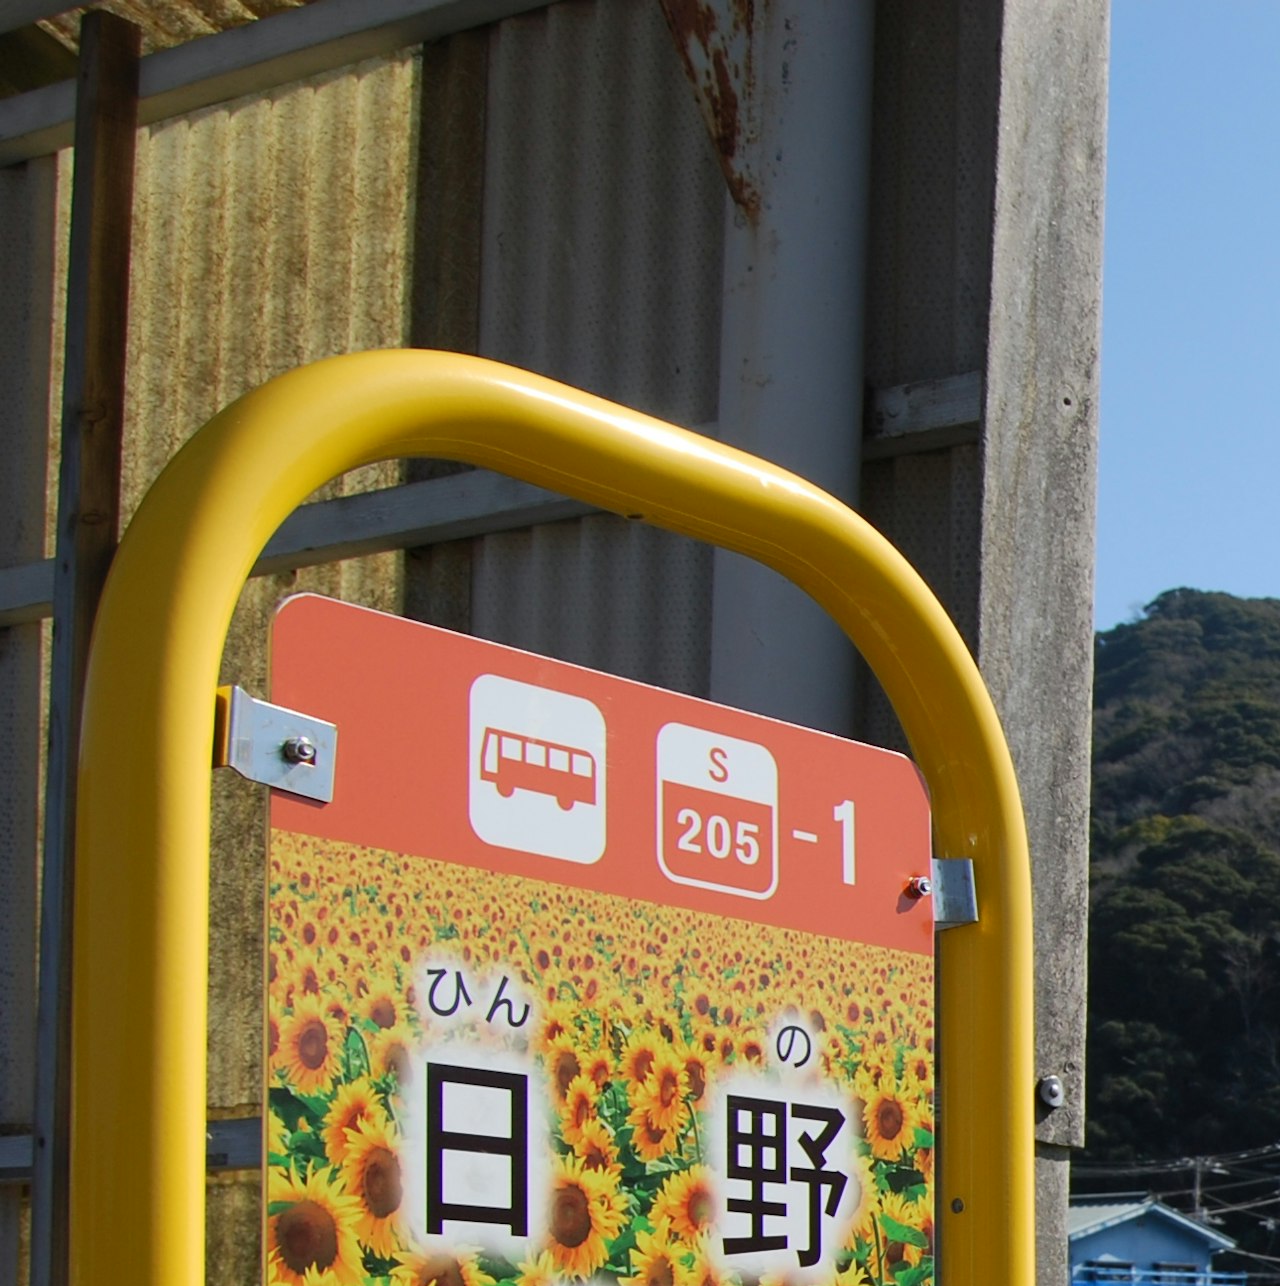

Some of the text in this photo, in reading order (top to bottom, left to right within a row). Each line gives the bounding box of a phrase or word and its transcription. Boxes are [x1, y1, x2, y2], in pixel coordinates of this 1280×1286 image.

[708, 748, 730, 782] S
[676, 807, 760, 867] 205
[425, 966, 531, 1029] ひん
[775, 1024, 812, 1069] の
